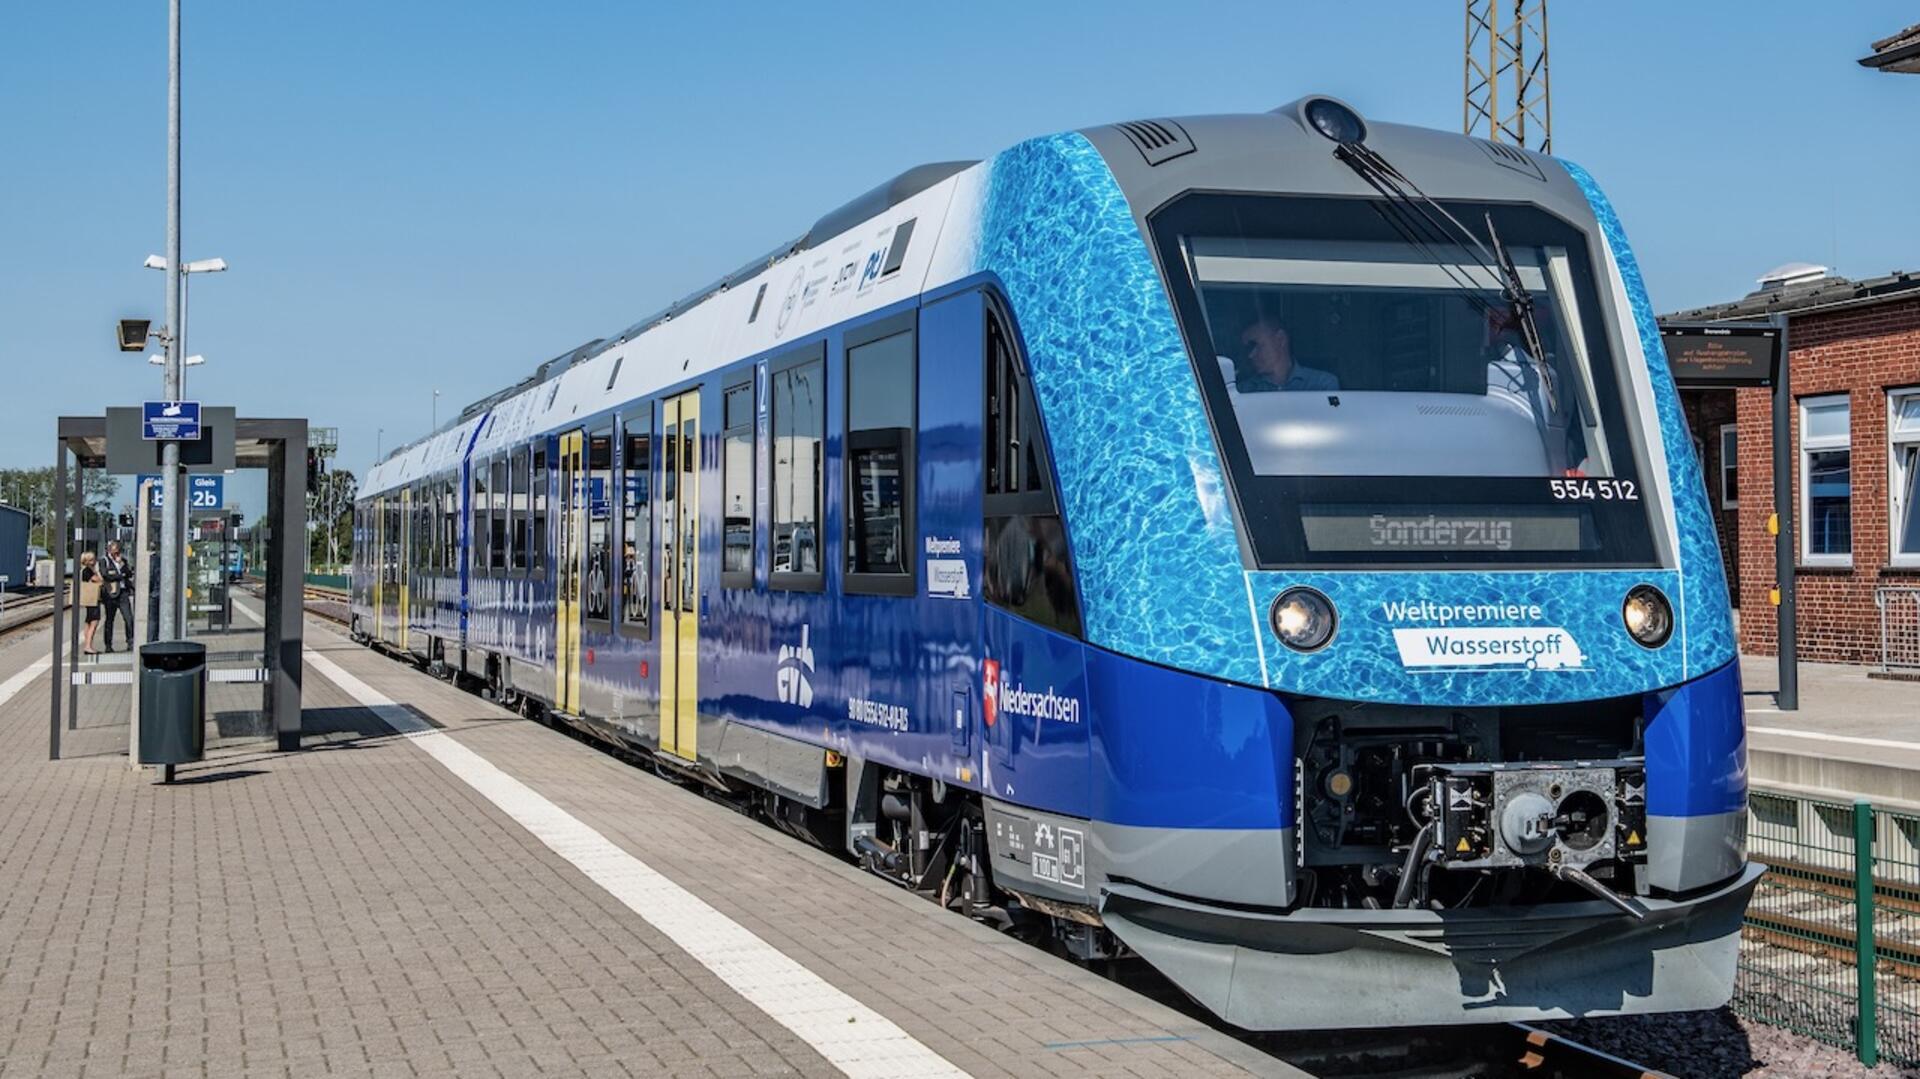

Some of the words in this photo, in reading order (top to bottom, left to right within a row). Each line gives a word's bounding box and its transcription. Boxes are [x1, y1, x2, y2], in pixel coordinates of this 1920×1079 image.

[195, 478, 216, 487] Gleis
[1551, 480, 1595, 500] 554
[1597, 480, 1639, 501] 512
[193, 490, 217, 506] 2b
[1369, 515, 1513, 551] Sonderzug
[925, 536, 961, 558] Weltpremiere
[1382, 600, 1542, 625] Weltpremiere
[1426, 634, 1563, 657] Wasserstoff
[999, 681, 1079, 724] Niedersachsen
